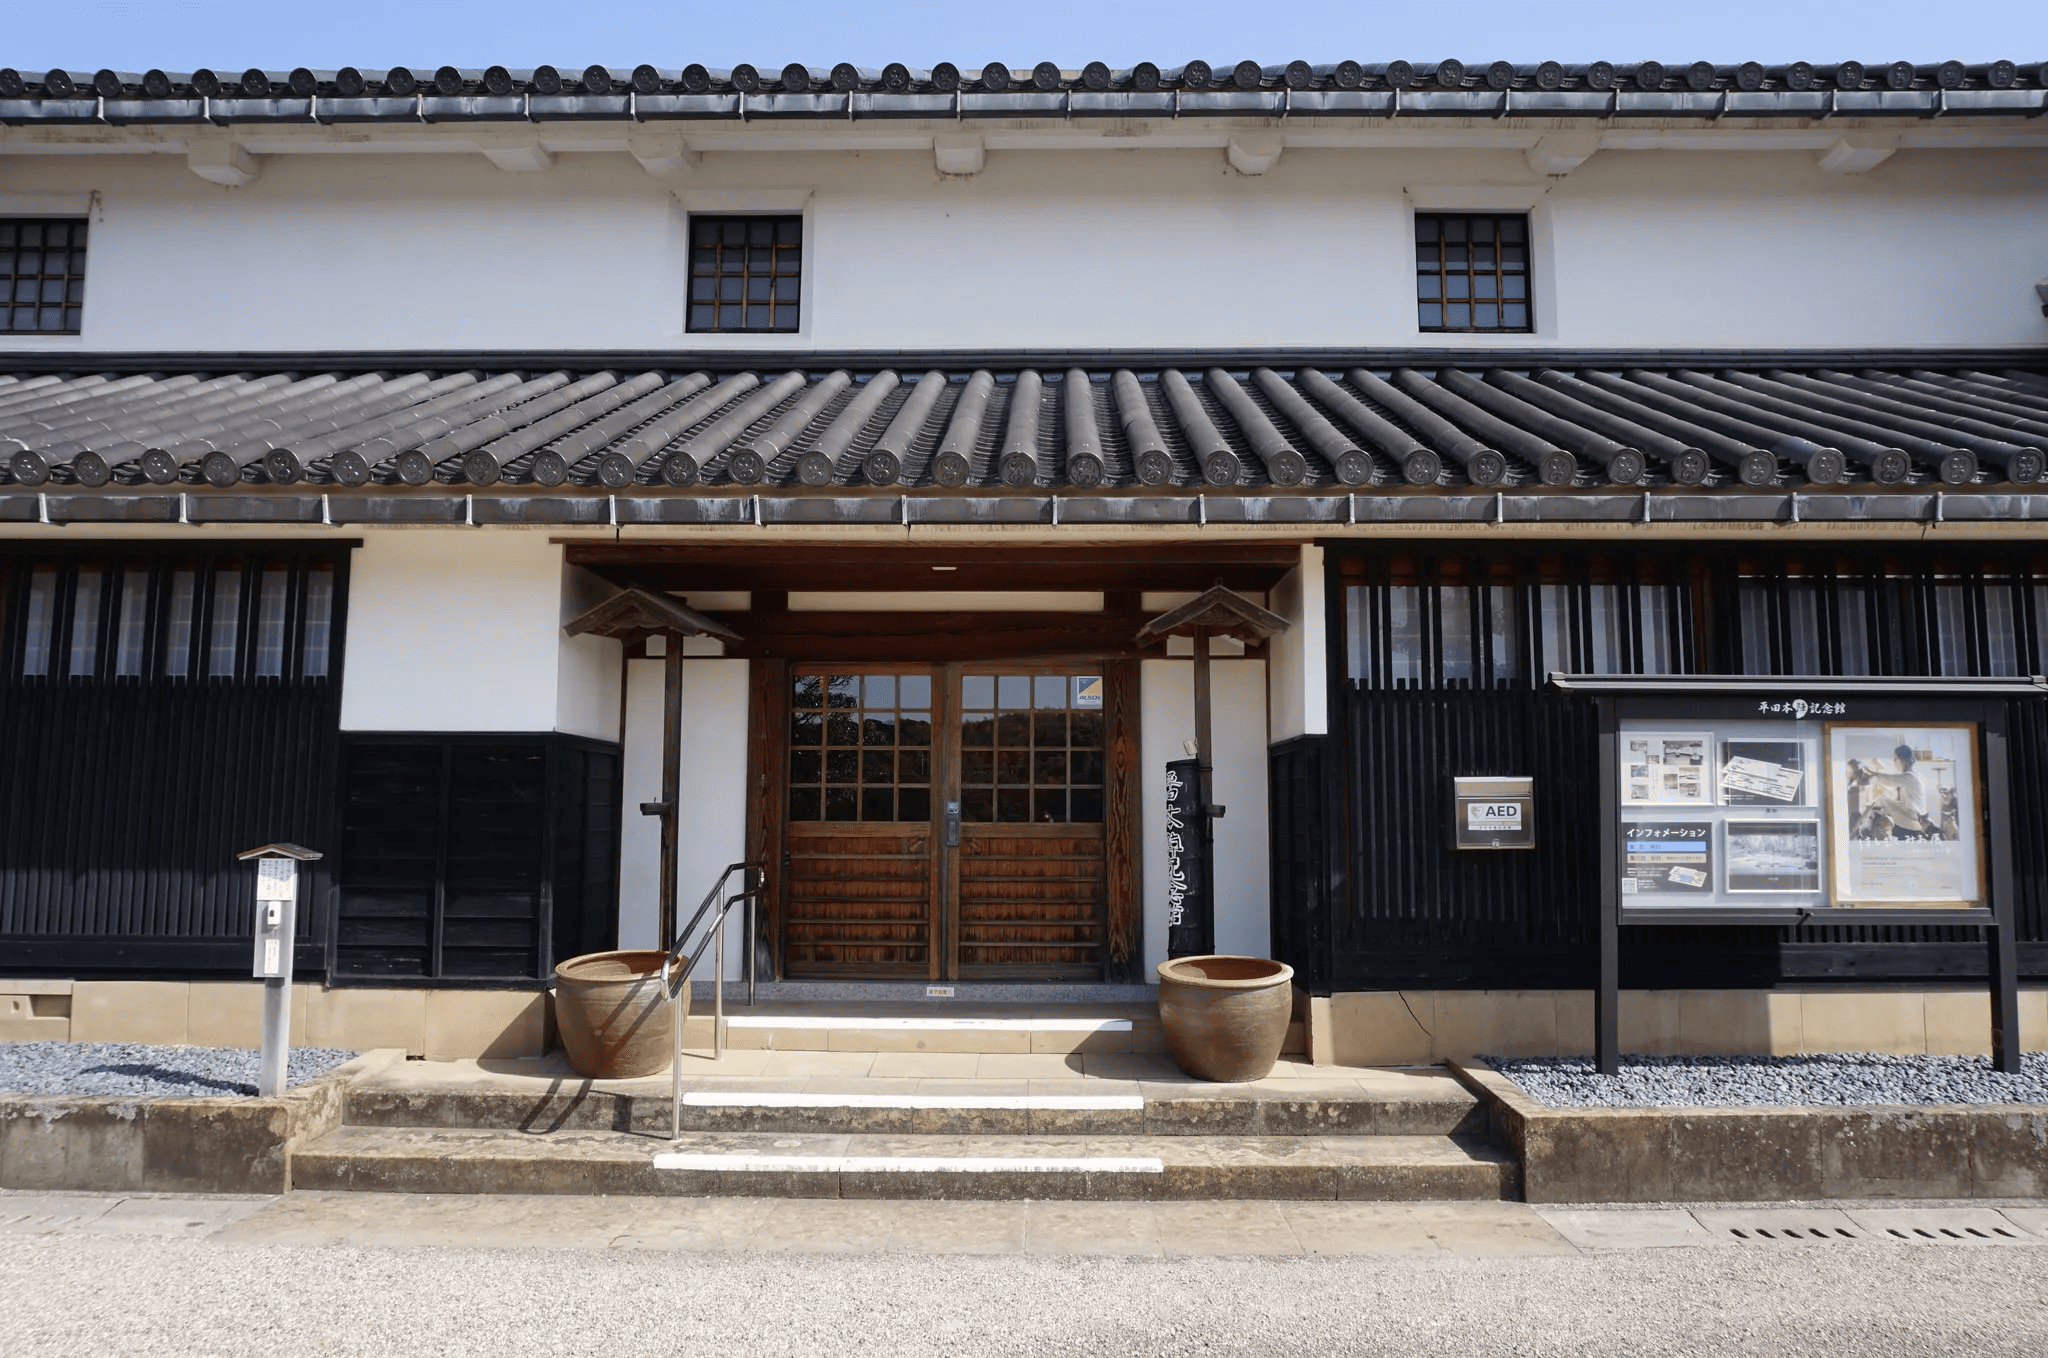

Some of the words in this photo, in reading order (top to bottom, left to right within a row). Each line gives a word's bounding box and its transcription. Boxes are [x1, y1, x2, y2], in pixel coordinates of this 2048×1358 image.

[1758, 700, 1847, 717] 平田本陣記念館
[1485, 806, 1517, 817] AED
[1626, 828, 1706, 838] インフォメーション
